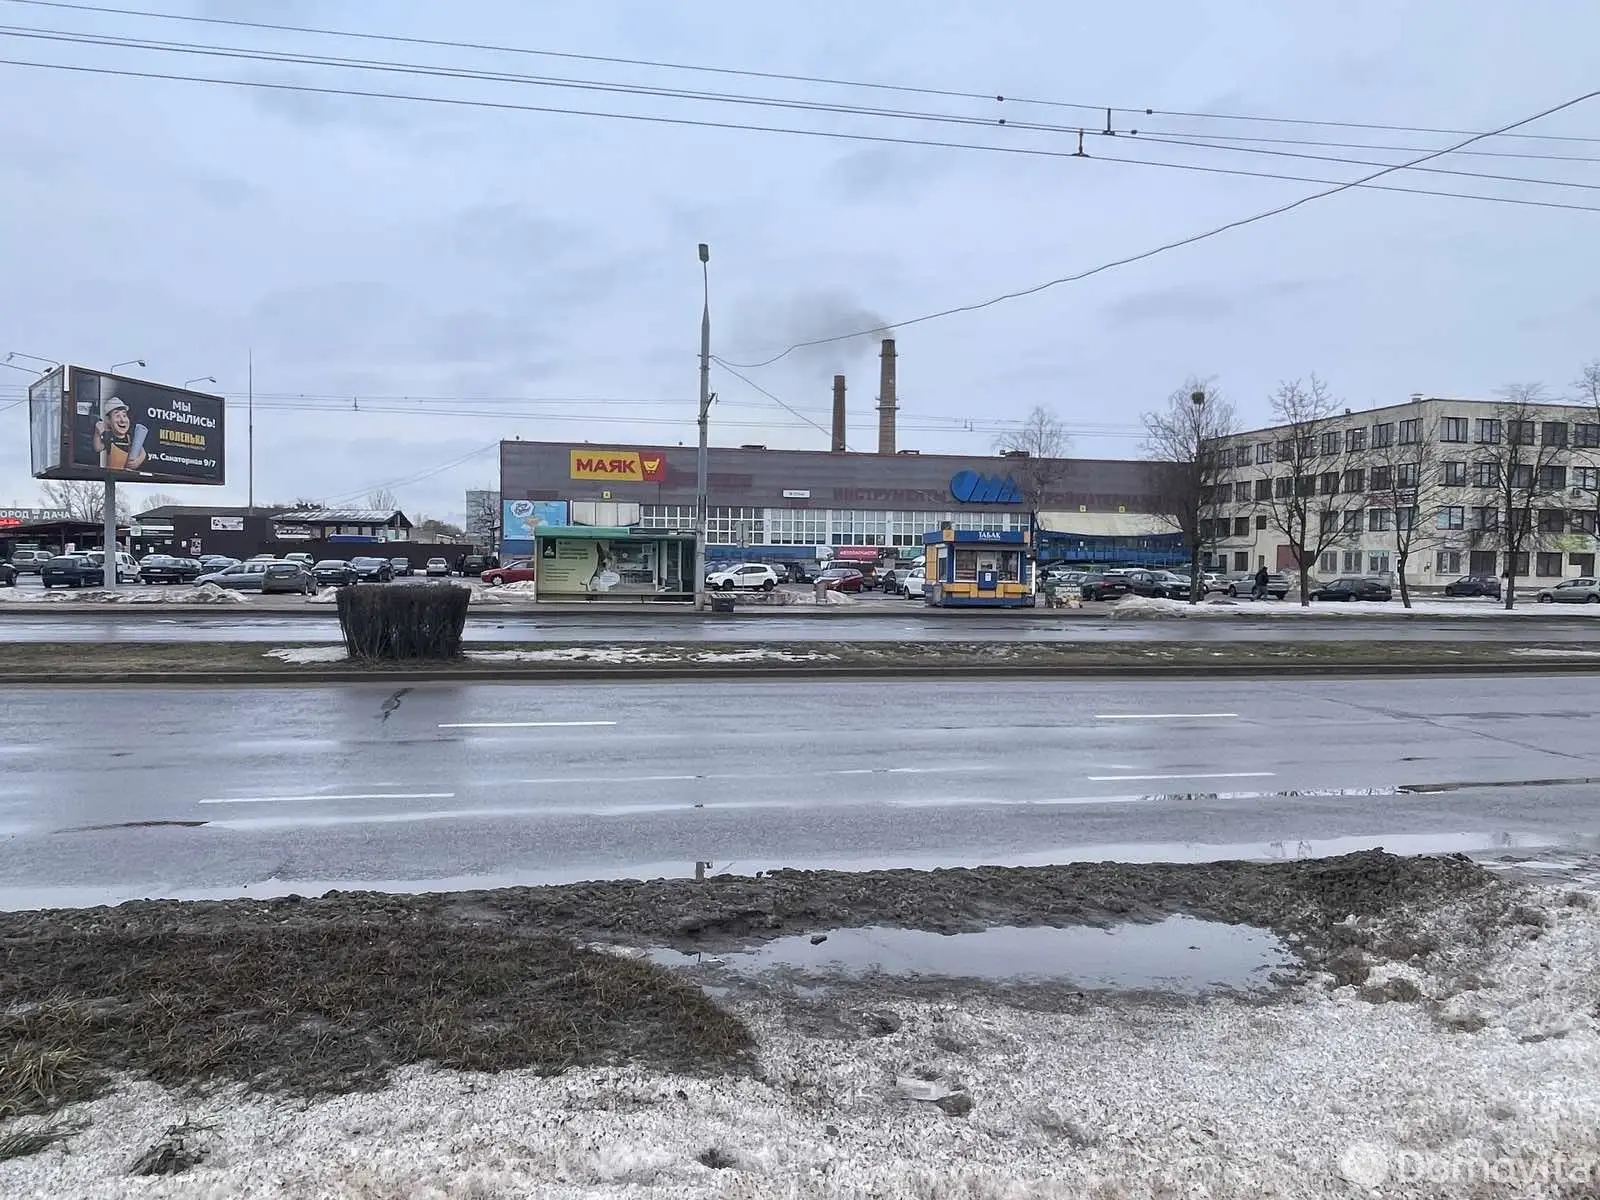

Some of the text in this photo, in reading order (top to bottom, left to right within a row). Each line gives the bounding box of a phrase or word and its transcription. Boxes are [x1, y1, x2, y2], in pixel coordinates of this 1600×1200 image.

[172, 400, 191, 412] МЫ
[147, 408, 216, 428] ОТКРЫЛИСЬ!
[203, 459, 216, 468] 9/7
[576, 458, 637, 473] МАЯК
[42, 511, 71, 520] ДАЧА
[979, 531, 1001, 539] ТАБАК
